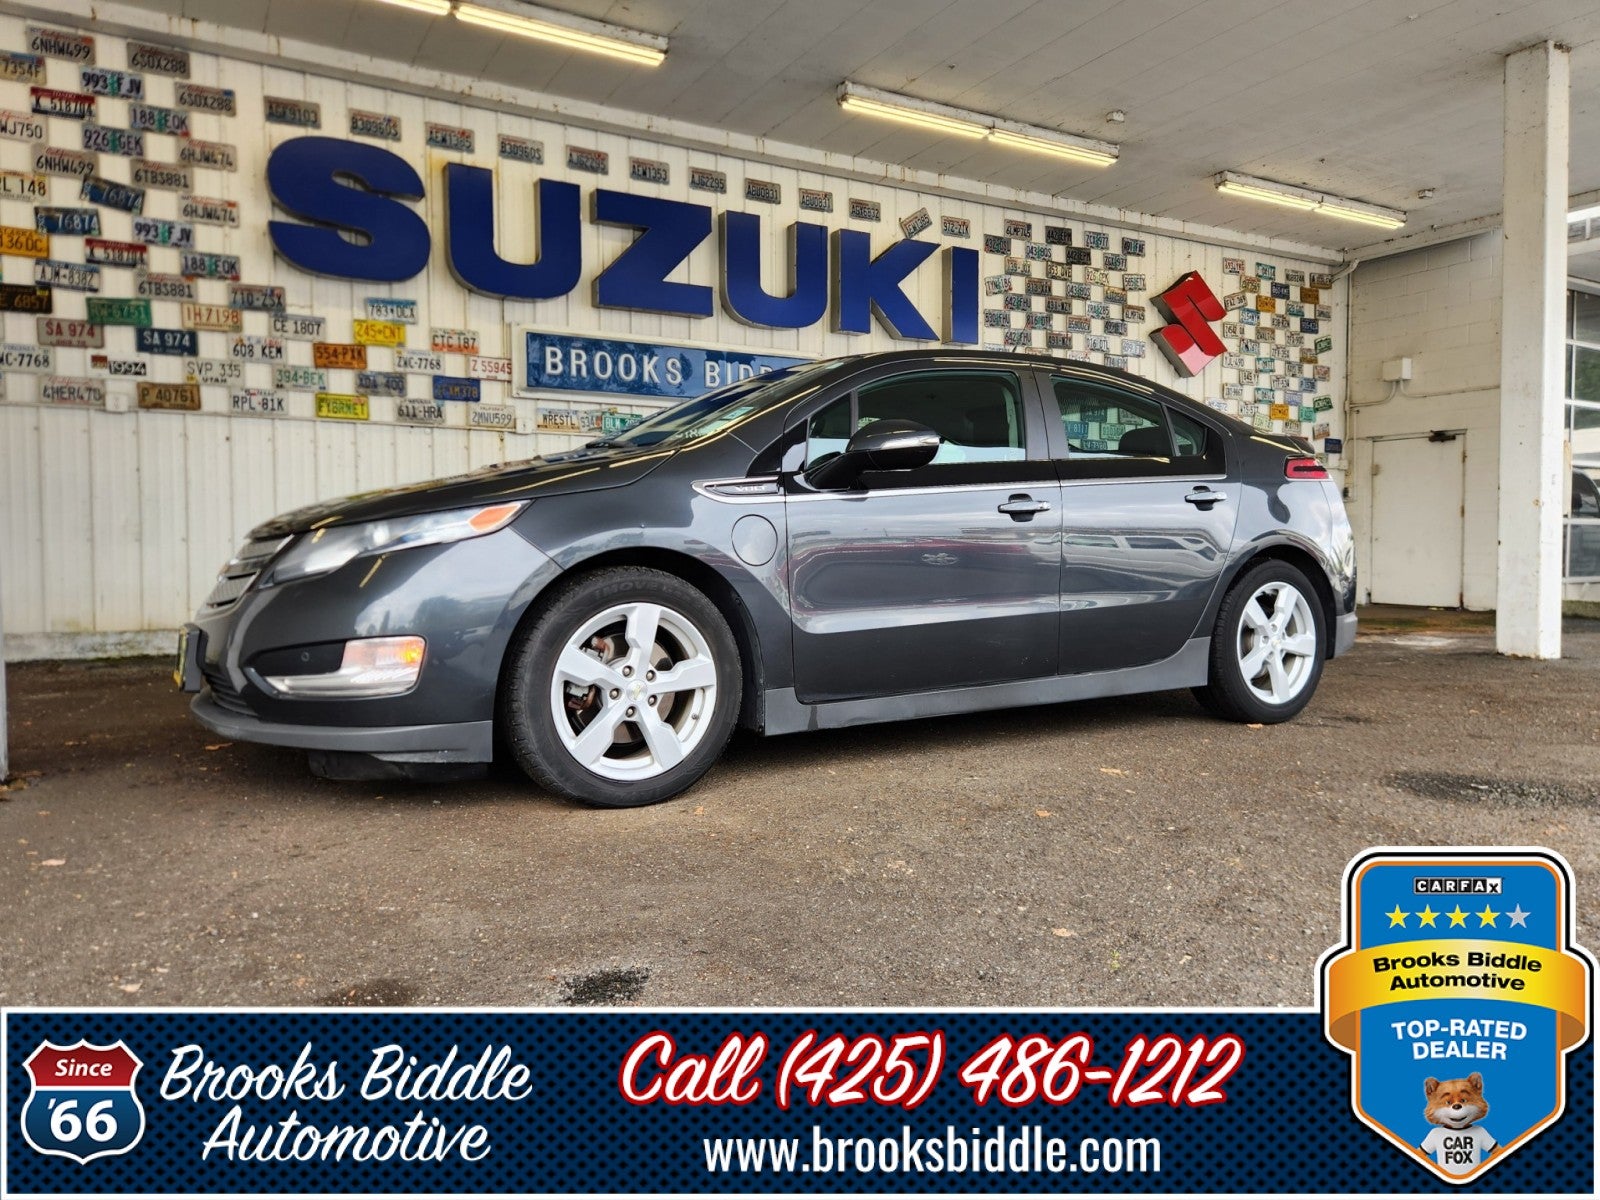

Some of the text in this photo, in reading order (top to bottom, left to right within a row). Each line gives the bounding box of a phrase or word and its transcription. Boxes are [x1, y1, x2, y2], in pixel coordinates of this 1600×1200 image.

[31, 36, 91, 59] 6NHW499
[82, 71, 108, 89] 993
[132, 107, 155, 125] 188
[84, 128, 110, 149] 926
[36, 155, 94, 175] 6NHW499
[180, 147, 233, 167] 6HJW474
[20, 178, 46, 196] 148
[182, 203, 235, 223] 6HJW474
[135, 222, 159, 239] 993
[266, 136, 980, 346] SUZUKI
[184, 256, 206, 272] 188
[45, 318, 96, 338] SA 974
[273, 319, 321, 335] CE 1807
[143, 331, 190, 347] SA 974
[233, 343, 254, 357] 608
[187, 361, 241, 378] SVP 335
[481, 361, 512, 375] 55945
[545, 346, 683, 386] BROOKS
[232, 395, 255, 410] RPL
